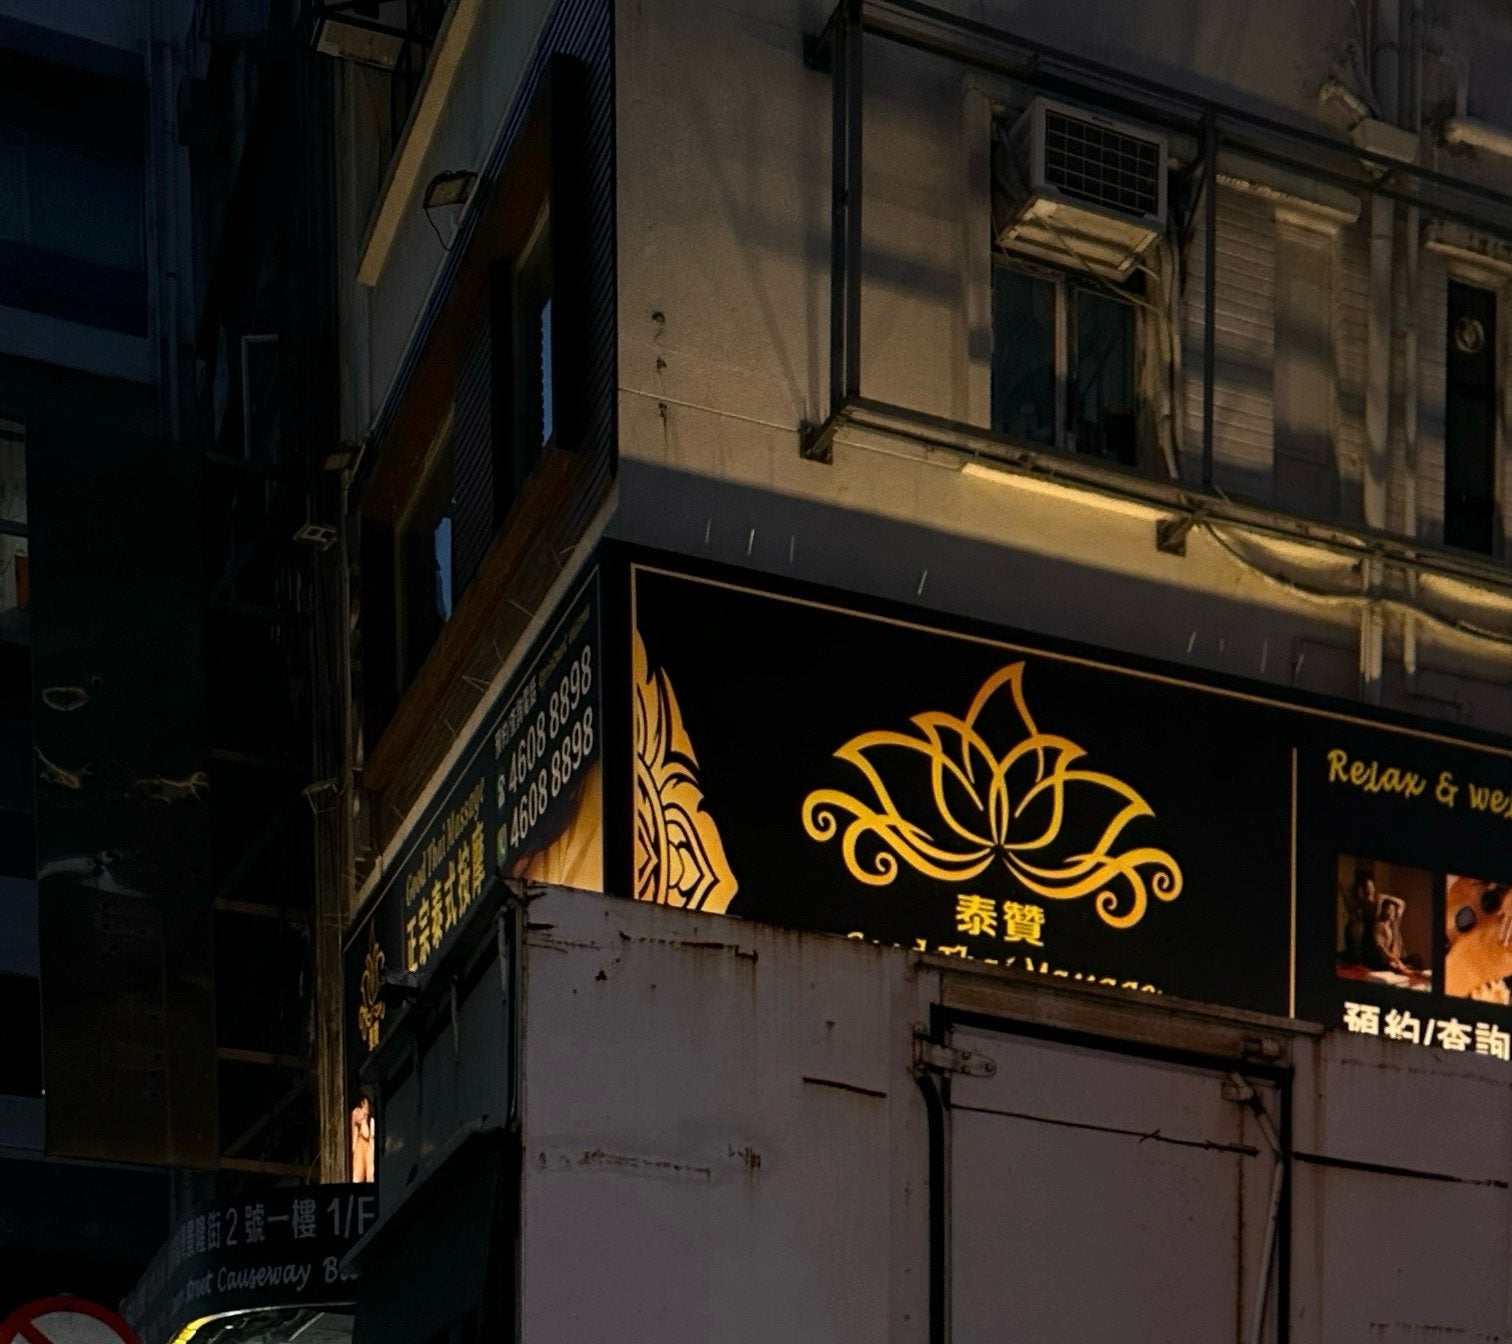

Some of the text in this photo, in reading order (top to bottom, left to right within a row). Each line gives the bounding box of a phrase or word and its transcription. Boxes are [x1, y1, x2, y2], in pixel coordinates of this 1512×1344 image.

[508, 711, 546, 794] 4608
[550, 645, 592, 740] 8898
[510, 768, 548, 849] 4608
[552, 706, 594, 798] 8898
[1328, 749, 1427, 799] Relax
[1435, 772, 1459, 808] &
[405, 820, 487, 974] 正宗泰式按摩
[326, 1195, 376, 1240] 1/F
[217, 1261, 312, 1293] Causeway
